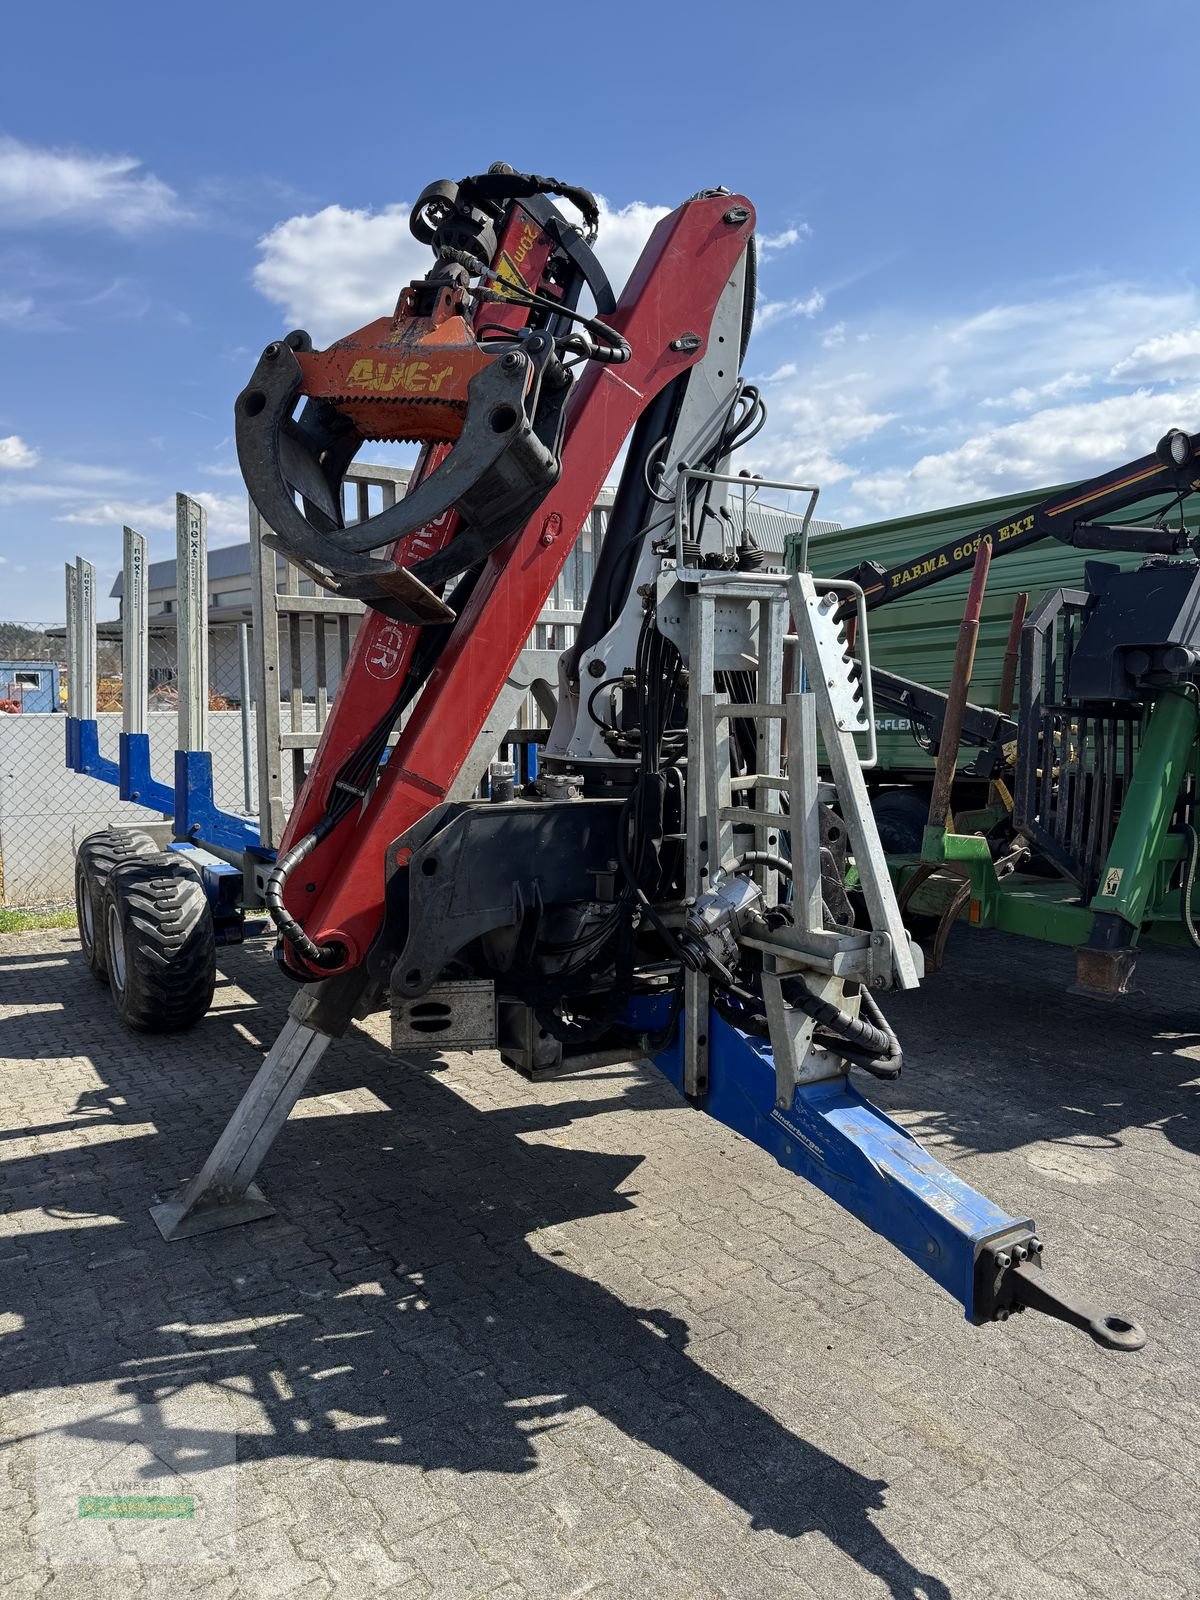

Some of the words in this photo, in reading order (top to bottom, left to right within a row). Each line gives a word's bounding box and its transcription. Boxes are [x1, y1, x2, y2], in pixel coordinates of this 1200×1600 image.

[891, 553, 950, 588] FARMA
[998, 514, 1035, 542] EXT
[771, 1109, 825, 1155] Binderberger
